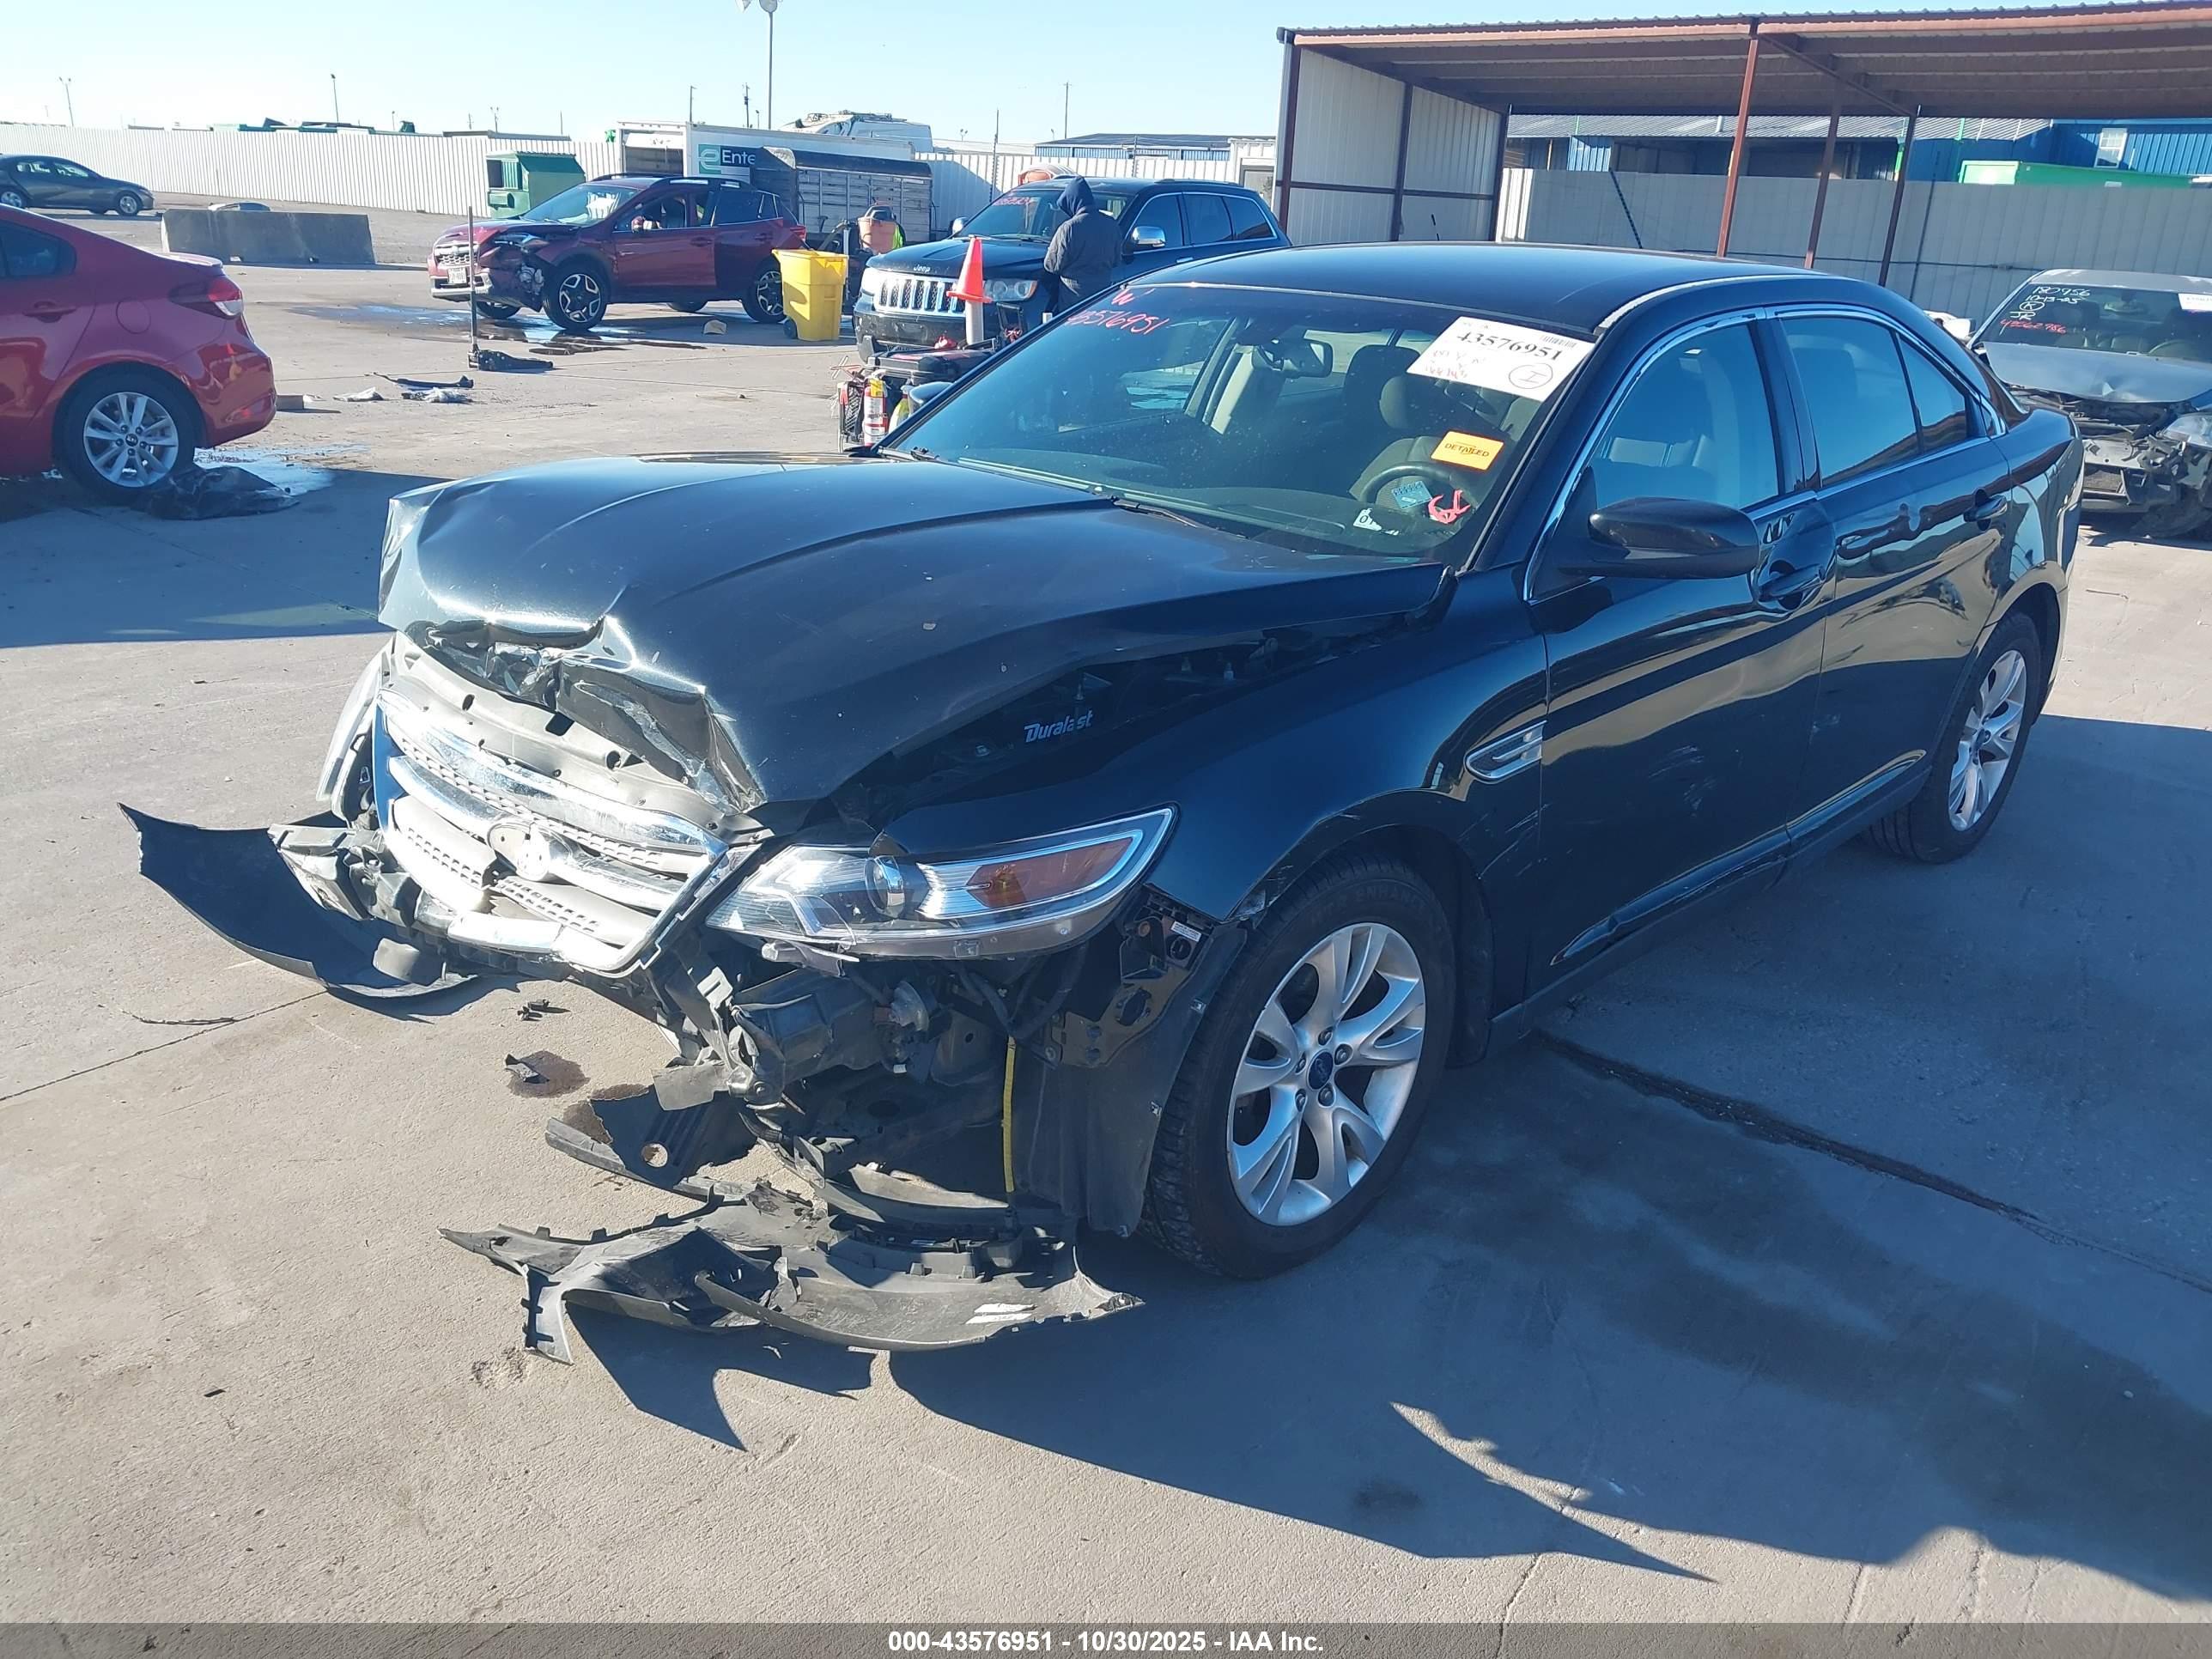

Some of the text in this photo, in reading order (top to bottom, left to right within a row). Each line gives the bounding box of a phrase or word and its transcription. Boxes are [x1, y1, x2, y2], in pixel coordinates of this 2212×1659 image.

[913, 264, 931, 273] Jeep
[1456, 331, 1563, 361] 43576951
[1024, 709, 1093, 743] Duralast
